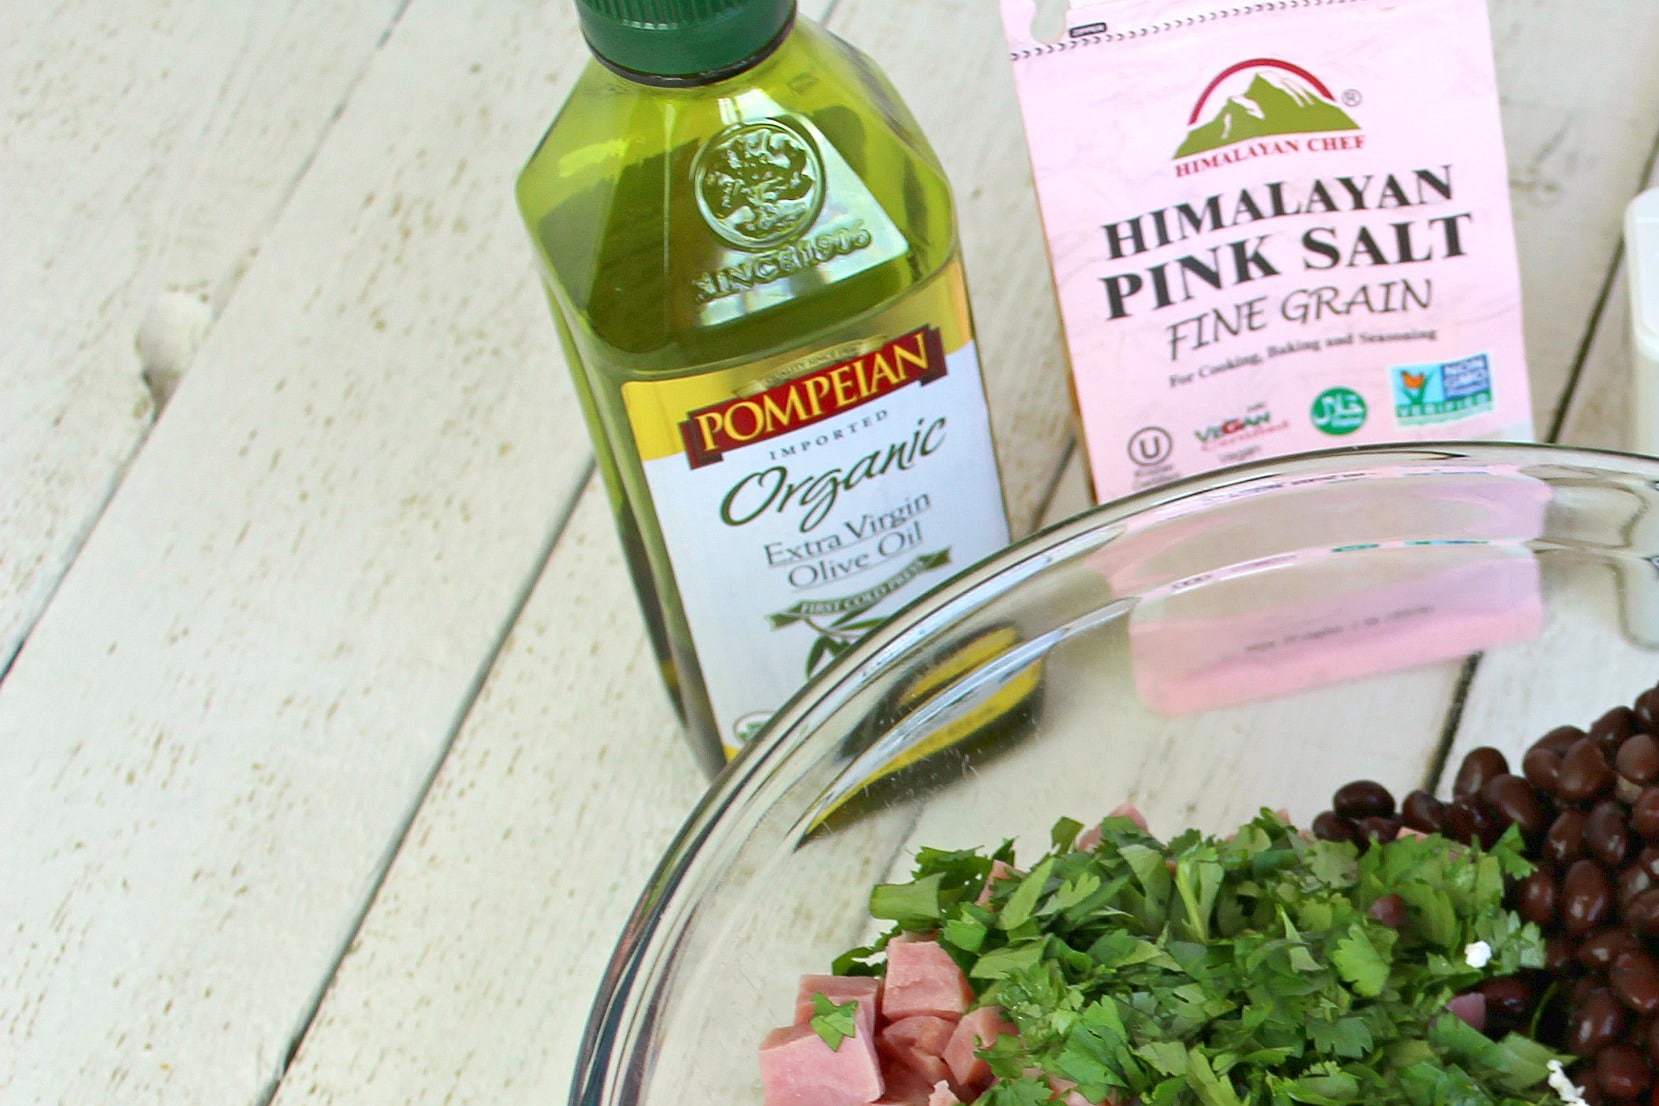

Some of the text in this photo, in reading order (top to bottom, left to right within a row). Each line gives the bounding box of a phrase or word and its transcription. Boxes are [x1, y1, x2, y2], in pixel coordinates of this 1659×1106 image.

[1175, 135, 1366, 178] HIMALAYAN CHEF
[1100, 164, 1453, 260] HIMALAYAN
[1098, 213, 1472, 320] PINK SALT
[1166, 278, 1432, 361] FINE GRAIN
[1325, 332, 1353, 346] and
[696, 331, 929, 452] POMPEIAN
[769, 409, 888, 461] IMPORTED
[719, 417, 947, 533] Organic
[763, 493, 933, 566] Extra Virgin
[787, 520, 924, 589] Olive Oil
